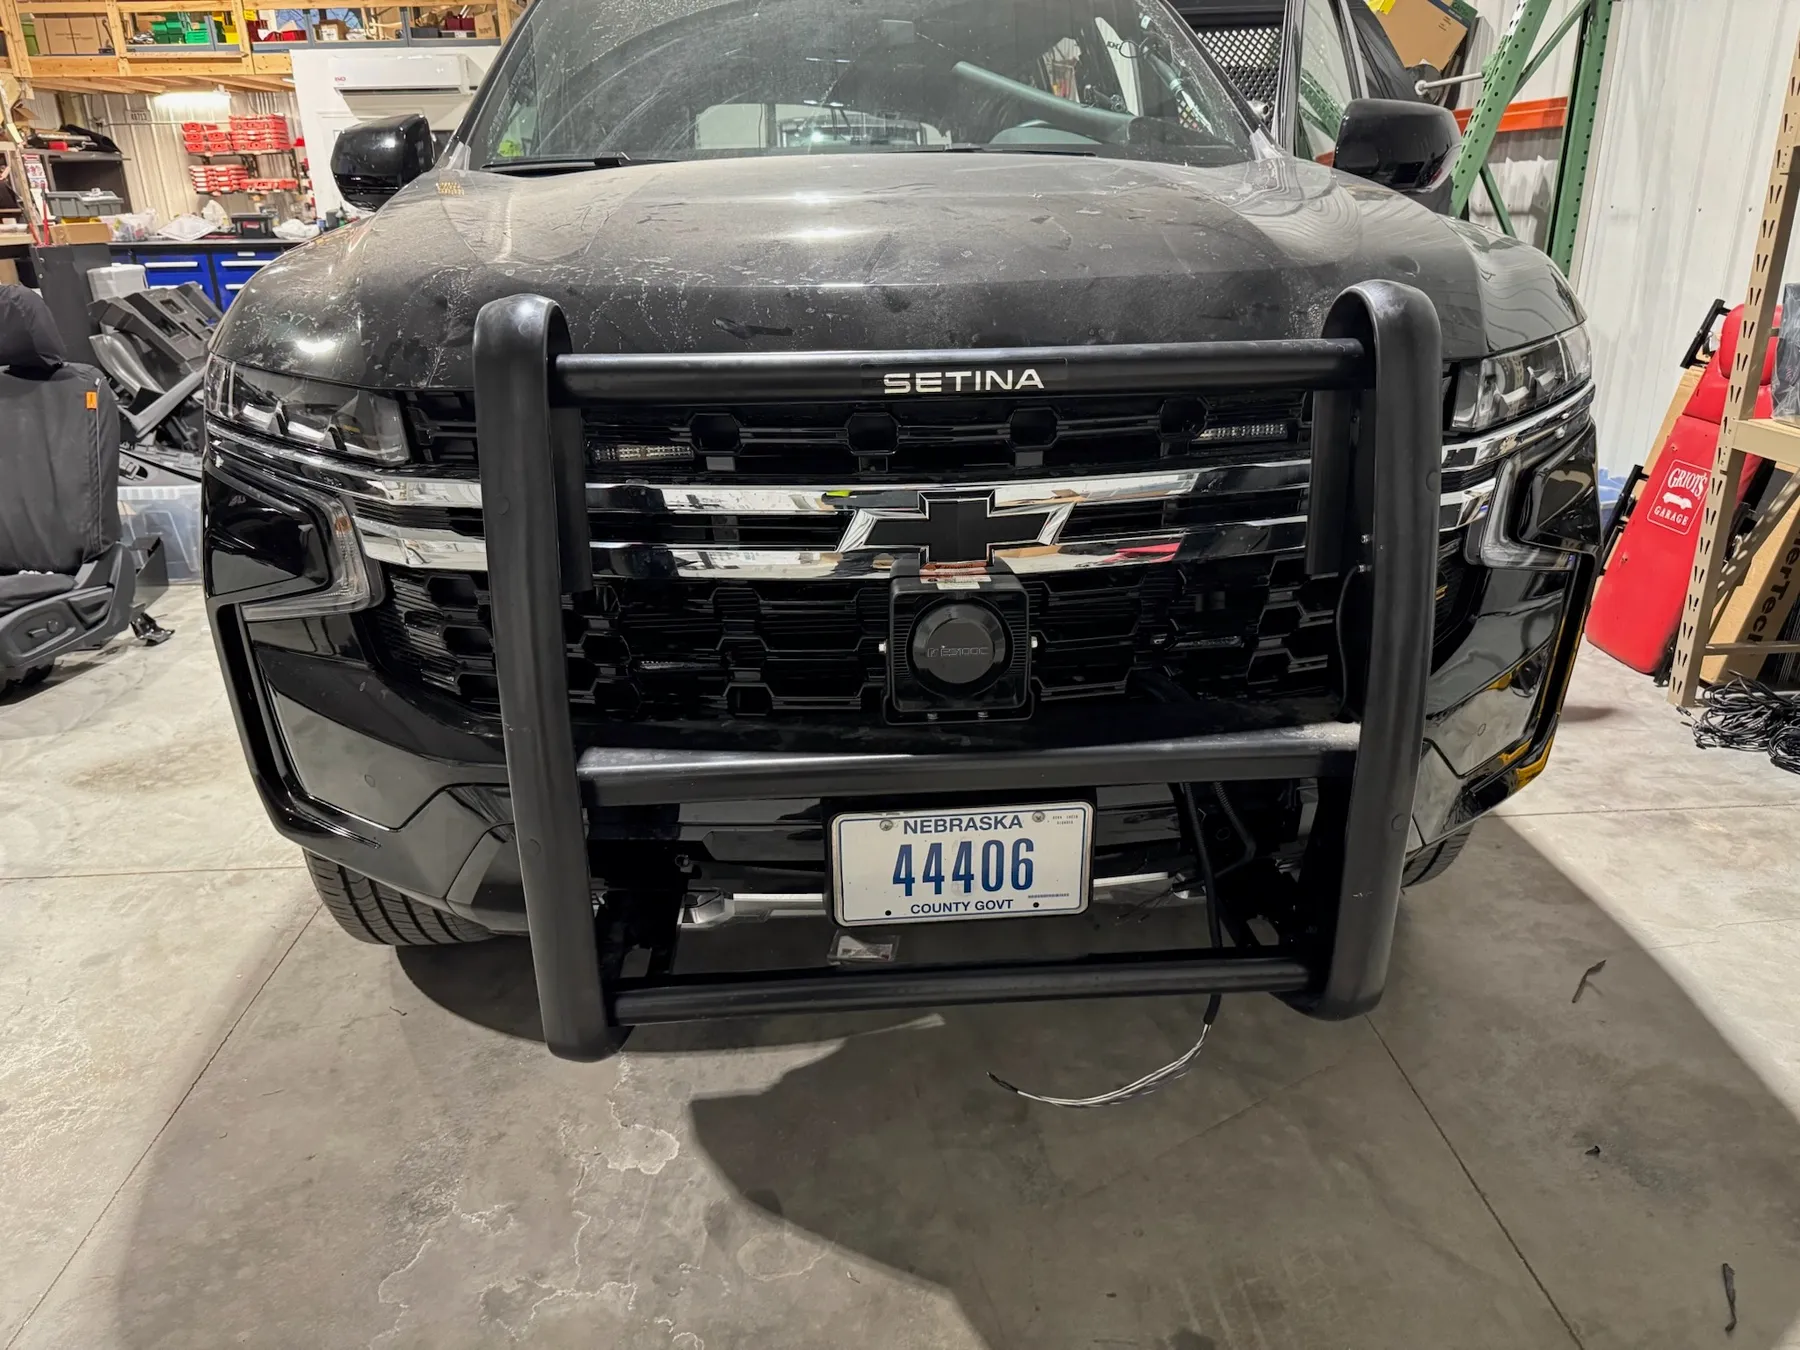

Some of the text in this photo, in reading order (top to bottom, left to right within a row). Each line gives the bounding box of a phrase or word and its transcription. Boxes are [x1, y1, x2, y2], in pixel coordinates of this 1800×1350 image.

[884, 368, 1045, 394] SETINA
[1654, 505, 1689, 526] GARAGE
[903, 814, 1023, 834] NEBRASKA
[892, 838, 1034, 897] 44406
[910, 899, 1014, 914] COUNTY GOVT
